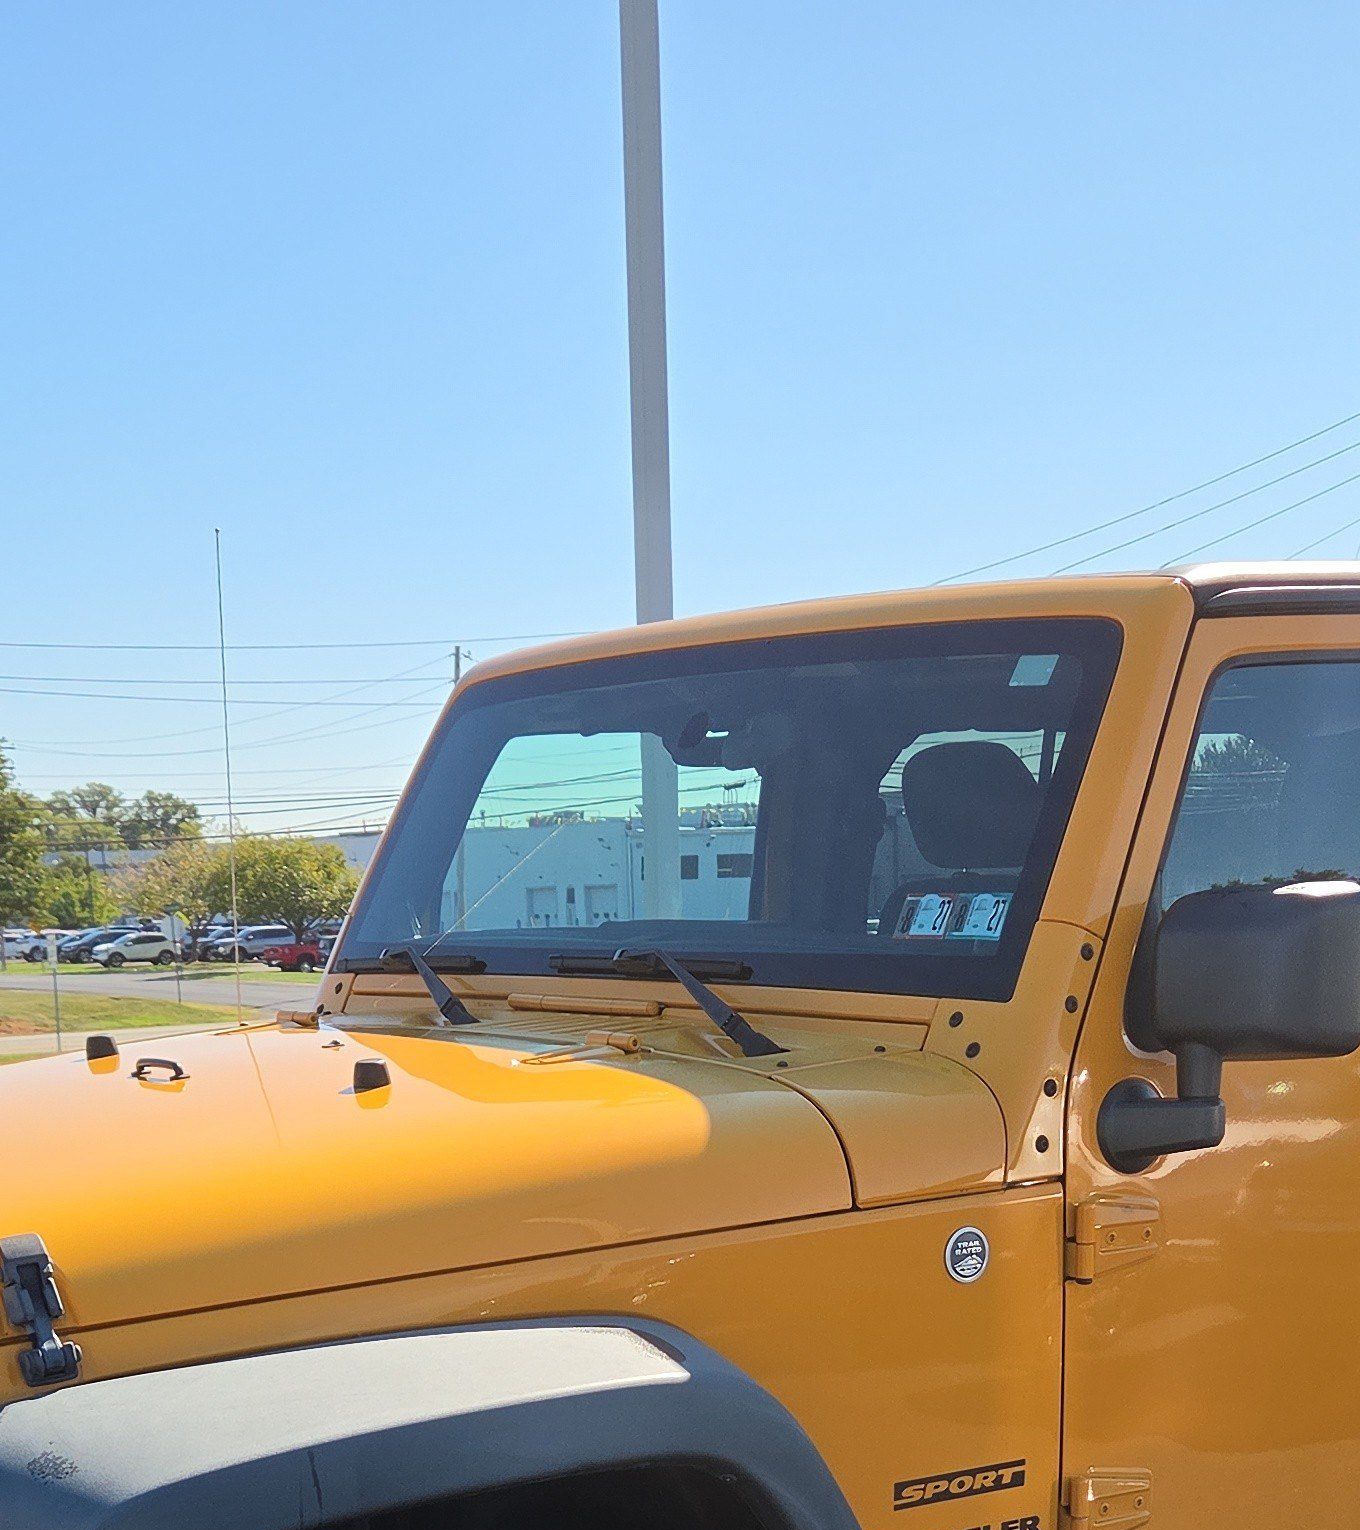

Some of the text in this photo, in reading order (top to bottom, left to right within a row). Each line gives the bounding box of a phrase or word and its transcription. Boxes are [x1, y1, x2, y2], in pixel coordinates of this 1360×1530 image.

[957, 1240, 980, 1249] TRAIL
[954, 1246, 983, 1256] RATED
[900, 1468, 1019, 1503] SPORT
